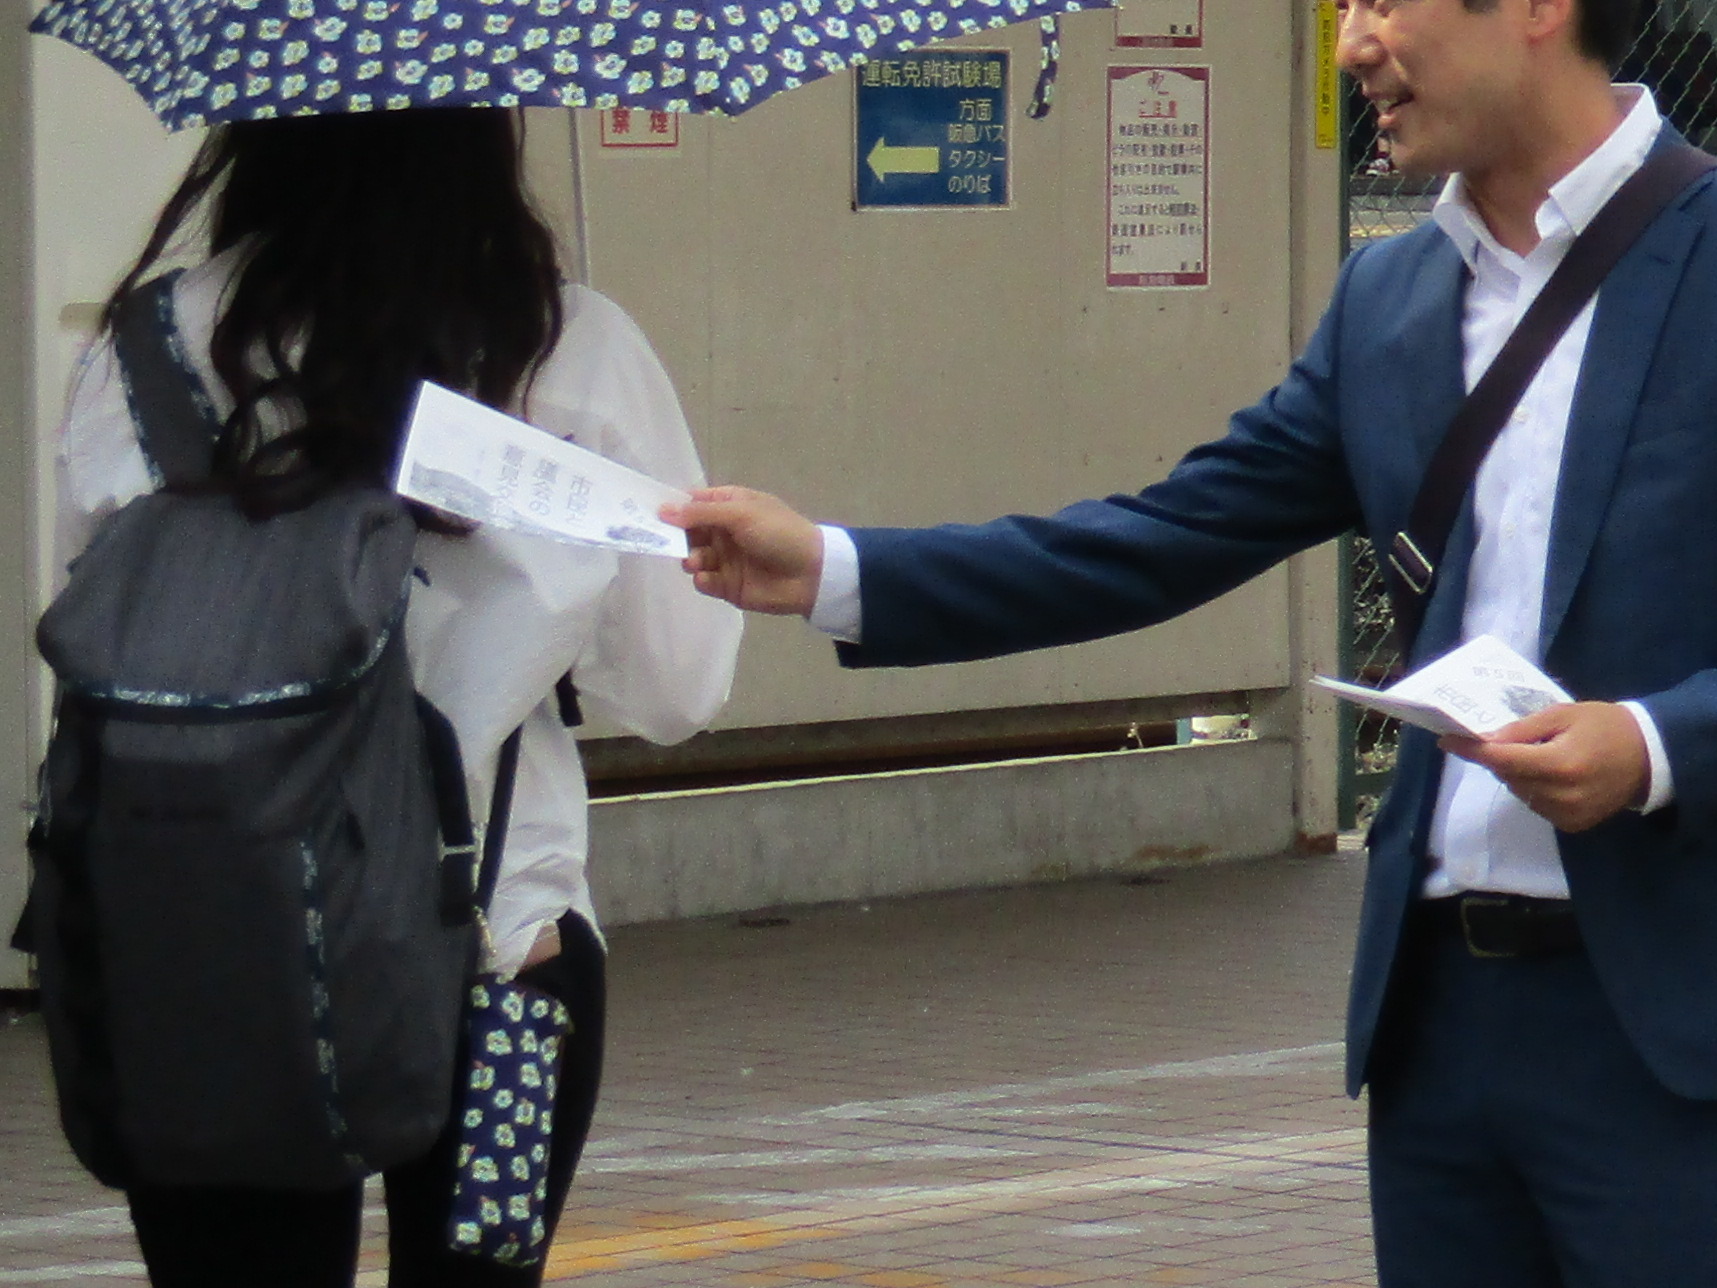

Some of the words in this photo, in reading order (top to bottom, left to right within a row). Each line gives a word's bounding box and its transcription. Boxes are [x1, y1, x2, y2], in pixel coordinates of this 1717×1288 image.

[862, 59, 1002, 88] 運転免許試験場
[959, 98, 993, 121] 方面
[948, 123, 1006, 143] 阪急バス
[949, 150, 1006, 168] タクシー
[948, 174, 992, 194] のりば
